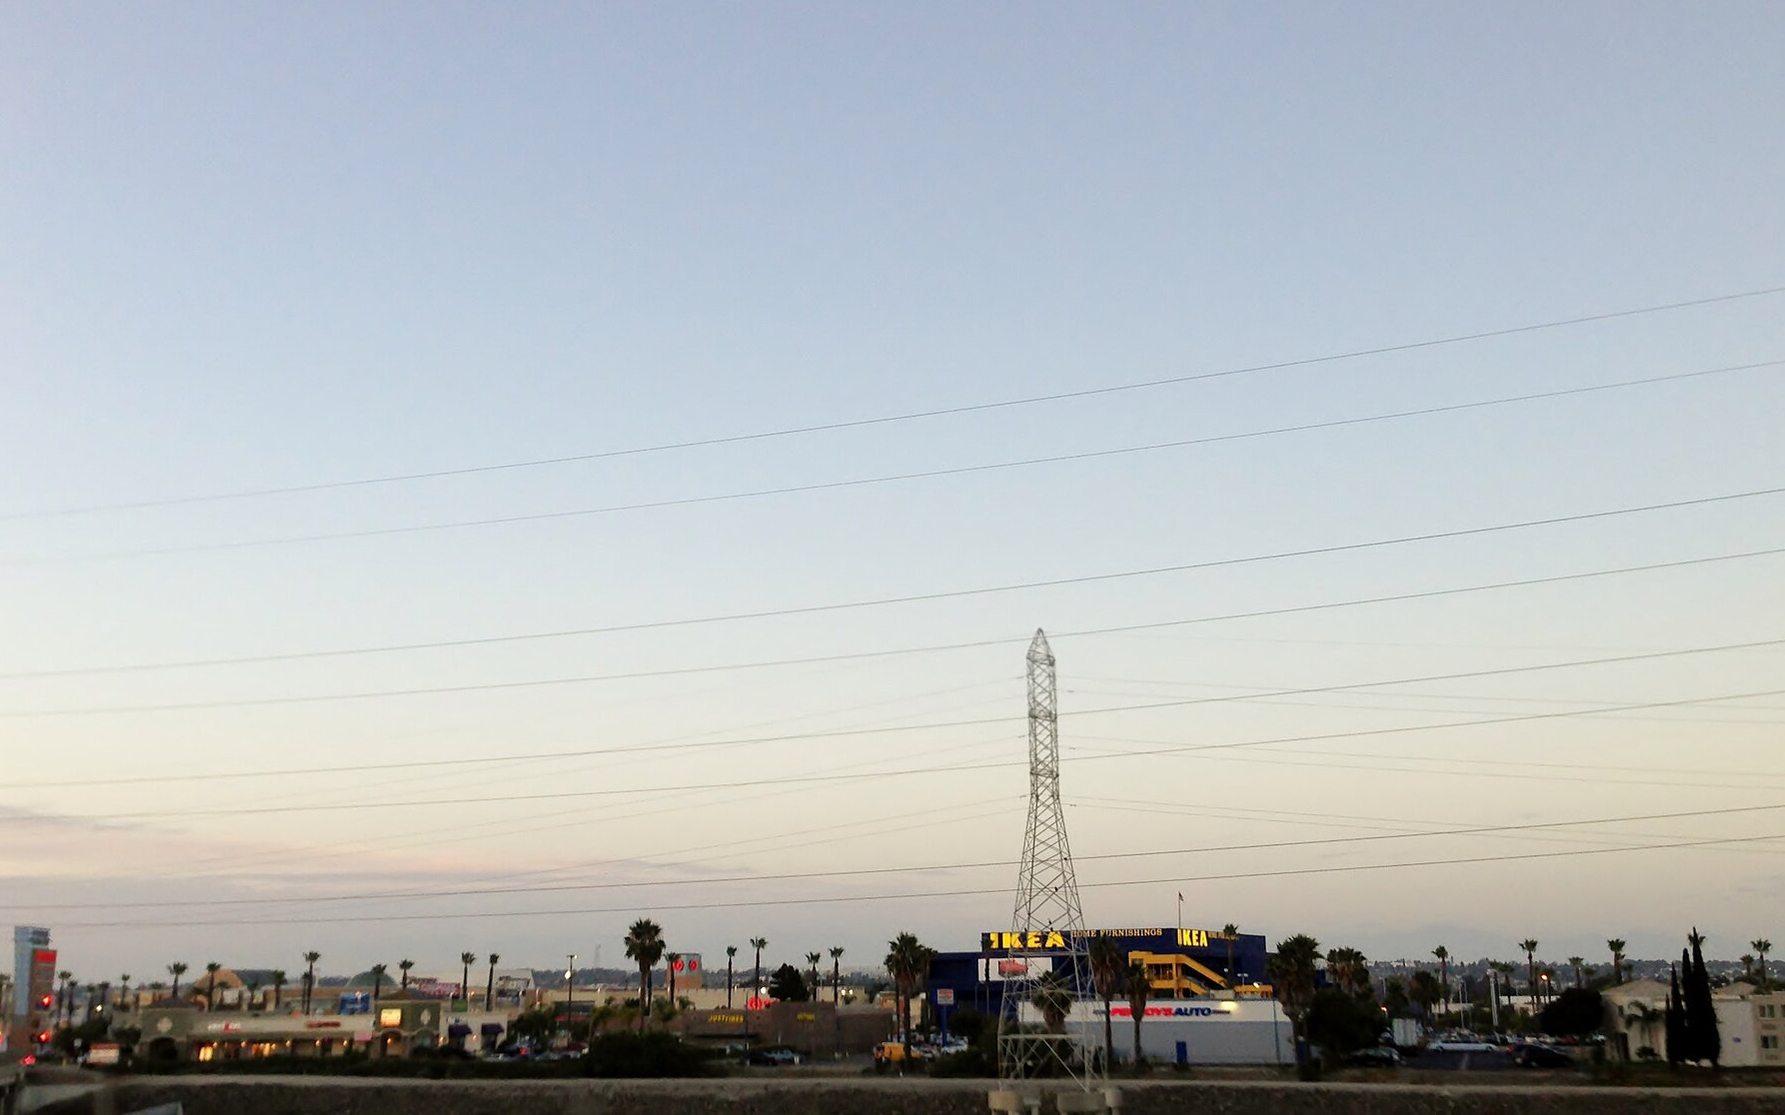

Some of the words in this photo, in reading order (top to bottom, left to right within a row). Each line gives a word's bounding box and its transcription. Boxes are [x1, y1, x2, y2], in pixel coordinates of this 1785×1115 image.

[1100, 928, 1162, 937] FURNISHINGS
[989, 932, 1065, 949] IKEA
[1177, 931, 1208, 948] IKEA
[1174, 1007, 1211, 1016] AUTO
